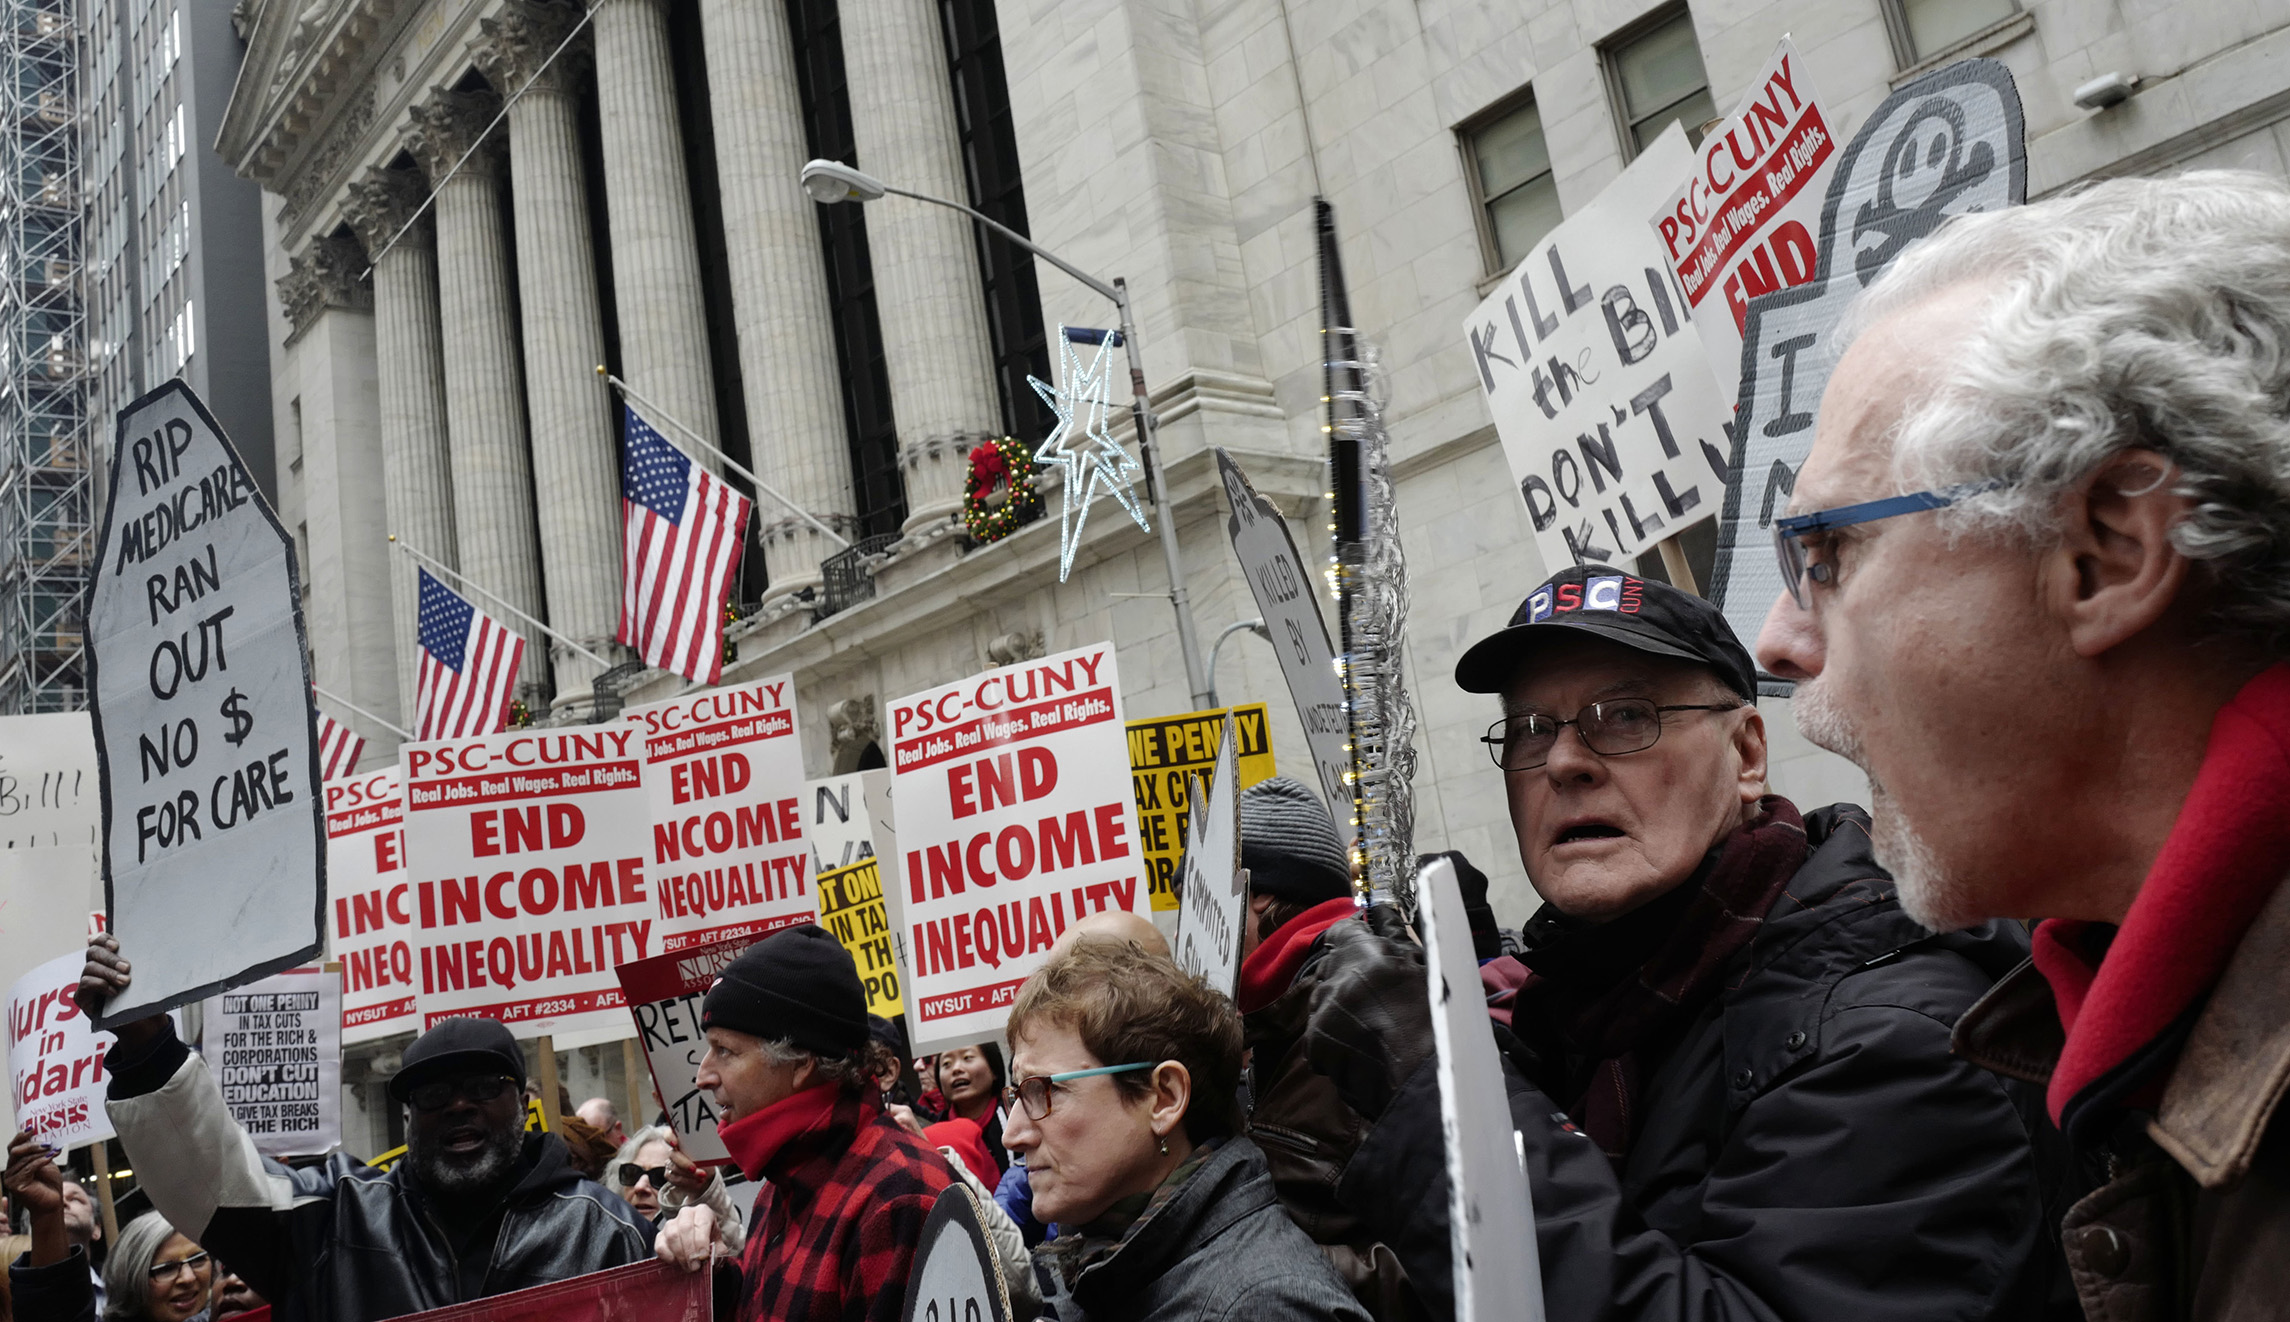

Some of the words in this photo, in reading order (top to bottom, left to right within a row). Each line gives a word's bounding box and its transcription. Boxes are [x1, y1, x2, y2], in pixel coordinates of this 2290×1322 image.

[1659, 52, 1801, 262] PSC-CUNY
[1682, 260, 1704, 297] Real
[1699, 240, 1719, 282] Jobs.
[1711, 216, 1732, 251] Real
[1726, 189, 1770, 235] Wages.
[1767, 158, 1794, 201] Real
[1789, 125, 1826, 173] Rights.
[1470, 242, 1594, 396] KILL
[1531, 346, 1601, 420] the
[132, 417, 193, 497] RIP
[1520, 372, 1681, 533] DON'T
[115, 462, 249, 576] MEDICARE
[1562, 469, 1701, 567] KILL
[146, 544, 221, 627] RAN
[1256, 553, 1299, 608] KILLED
[1526, 575, 1624, 624] PSC
[1619, 576, 1645, 614] CUNY
[149, 605, 235, 700] OUT
[1284, 617, 1312, 667] BY
[894, 651, 1105, 738] PSC-CUNY
[139, 717, 199, 784] NO
[219, 686, 254, 748] $
[408, 730, 634, 778] PSC-CUNY
[654, 740, 675, 757] Jobs.
[676, 734, 695, 751] Real
[696, 729, 730, 747] Wages.
[731, 721, 754, 739] Real
[755, 715, 790, 736] Rights.
[897, 741, 923, 766] Real
[925, 735, 954, 759] Jobs.
[955, 725, 981, 749] Real
[982, 718, 1029, 740] Wages.
[1030, 705, 1061, 729] Real
[1063, 697, 1111, 722] Rights.
[1127, 727, 1161, 768] NE
[327, 776, 399, 811] PSC-
[412, 784, 441, 804] Real
[444, 782, 478, 800] Jobs.
[481, 777, 510, 796] Real
[512, 773, 559, 794] Wages.
[562, 769, 591, 787] Real
[593, 766, 637, 787] Rights.
[670, 752, 751, 805] END
[947, 746, 1058, 820] END
[136, 789, 202, 865] FOR
[210, 748, 294, 831] CARE
[330, 814, 353, 833] Real
[354, 810, 381, 828] Jobs.
[381, 806, 402, 820] Rea
[470, 803, 586, 858] END
[653, 797, 802, 865] NCOME
[907, 802, 1130, 904] INCOME
[335, 884, 411, 938] INC
[418, 857, 647, 929] INCOME
[657, 853, 807, 921] NEQUALITY
[1187, 856, 1230, 967] COMMITTED
[420, 919, 652, 995] INEQUALITY
[700, 931, 718, 945] AFT
[339, 940, 412, 995] INEQ
[9, 982, 80, 1057] Nurs
[223, 995, 249, 1014] NOT
[250, 994, 275, 1012] ONE
[276, 993, 318, 1011] PENNY
[239, 1015, 250, 1030] IN
[253, 1014, 272, 1030] TAX
[275, 1013, 301, 1029] CUTS
[346, 1006, 388, 1025] NYSUT
[502, 1004, 530, 1020] AFT
[534, 999, 576, 1016] #2334
[925, 994, 972, 1018] NYSUT
[991, 985, 1016, 1005] AFT
[39, 1028, 65, 1057] in
[223, 1047, 317, 1066] CORPORATIONS
[224, 1032, 247, 1048] FOR
[250, 1031, 272, 1047] THE
[276, 1030, 304, 1045] RICH
[308, 1029, 317, 1044] &
[223, 1065, 277, 1086] DON'T
[282, 1064, 317, 1082] CUT
[223, 1082, 317, 1102] EDUCATION
[237, 1105, 259, 1120] GIVE
[261, 1105, 278, 1119] TAX
[281, 1103, 319, 1118] BREAKS
[246, 1120, 276, 1134] THE
[281, 1118, 319, 1132] RICH
